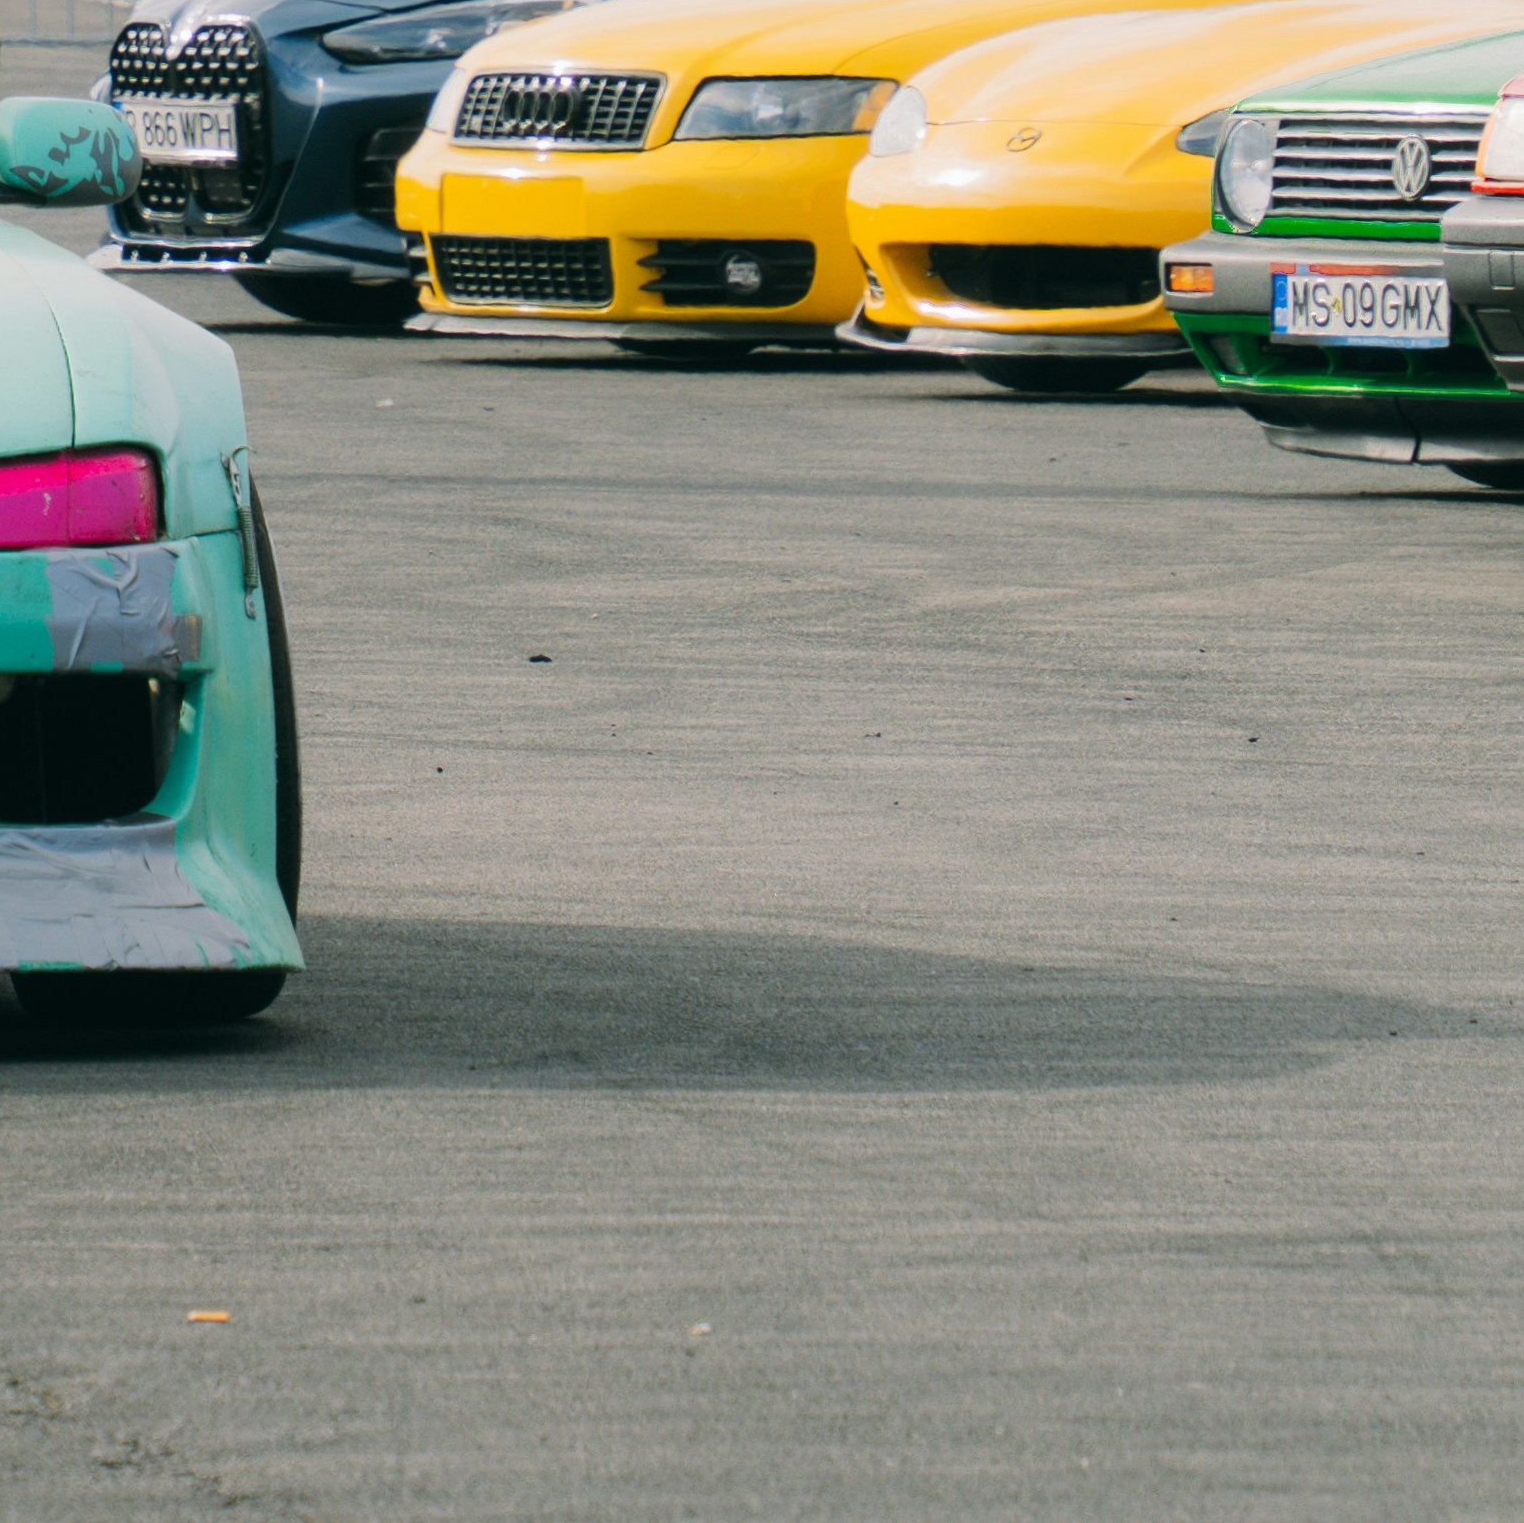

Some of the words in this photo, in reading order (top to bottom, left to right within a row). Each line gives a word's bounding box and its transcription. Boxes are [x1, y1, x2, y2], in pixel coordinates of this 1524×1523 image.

[143, 111, 178, 147] 866
[179, 111, 233, 150] WPH
[1291, 280, 1331, 327] MS
[1341, 281, 1375, 328] 09
[1381, 282, 1443, 331] GMX
